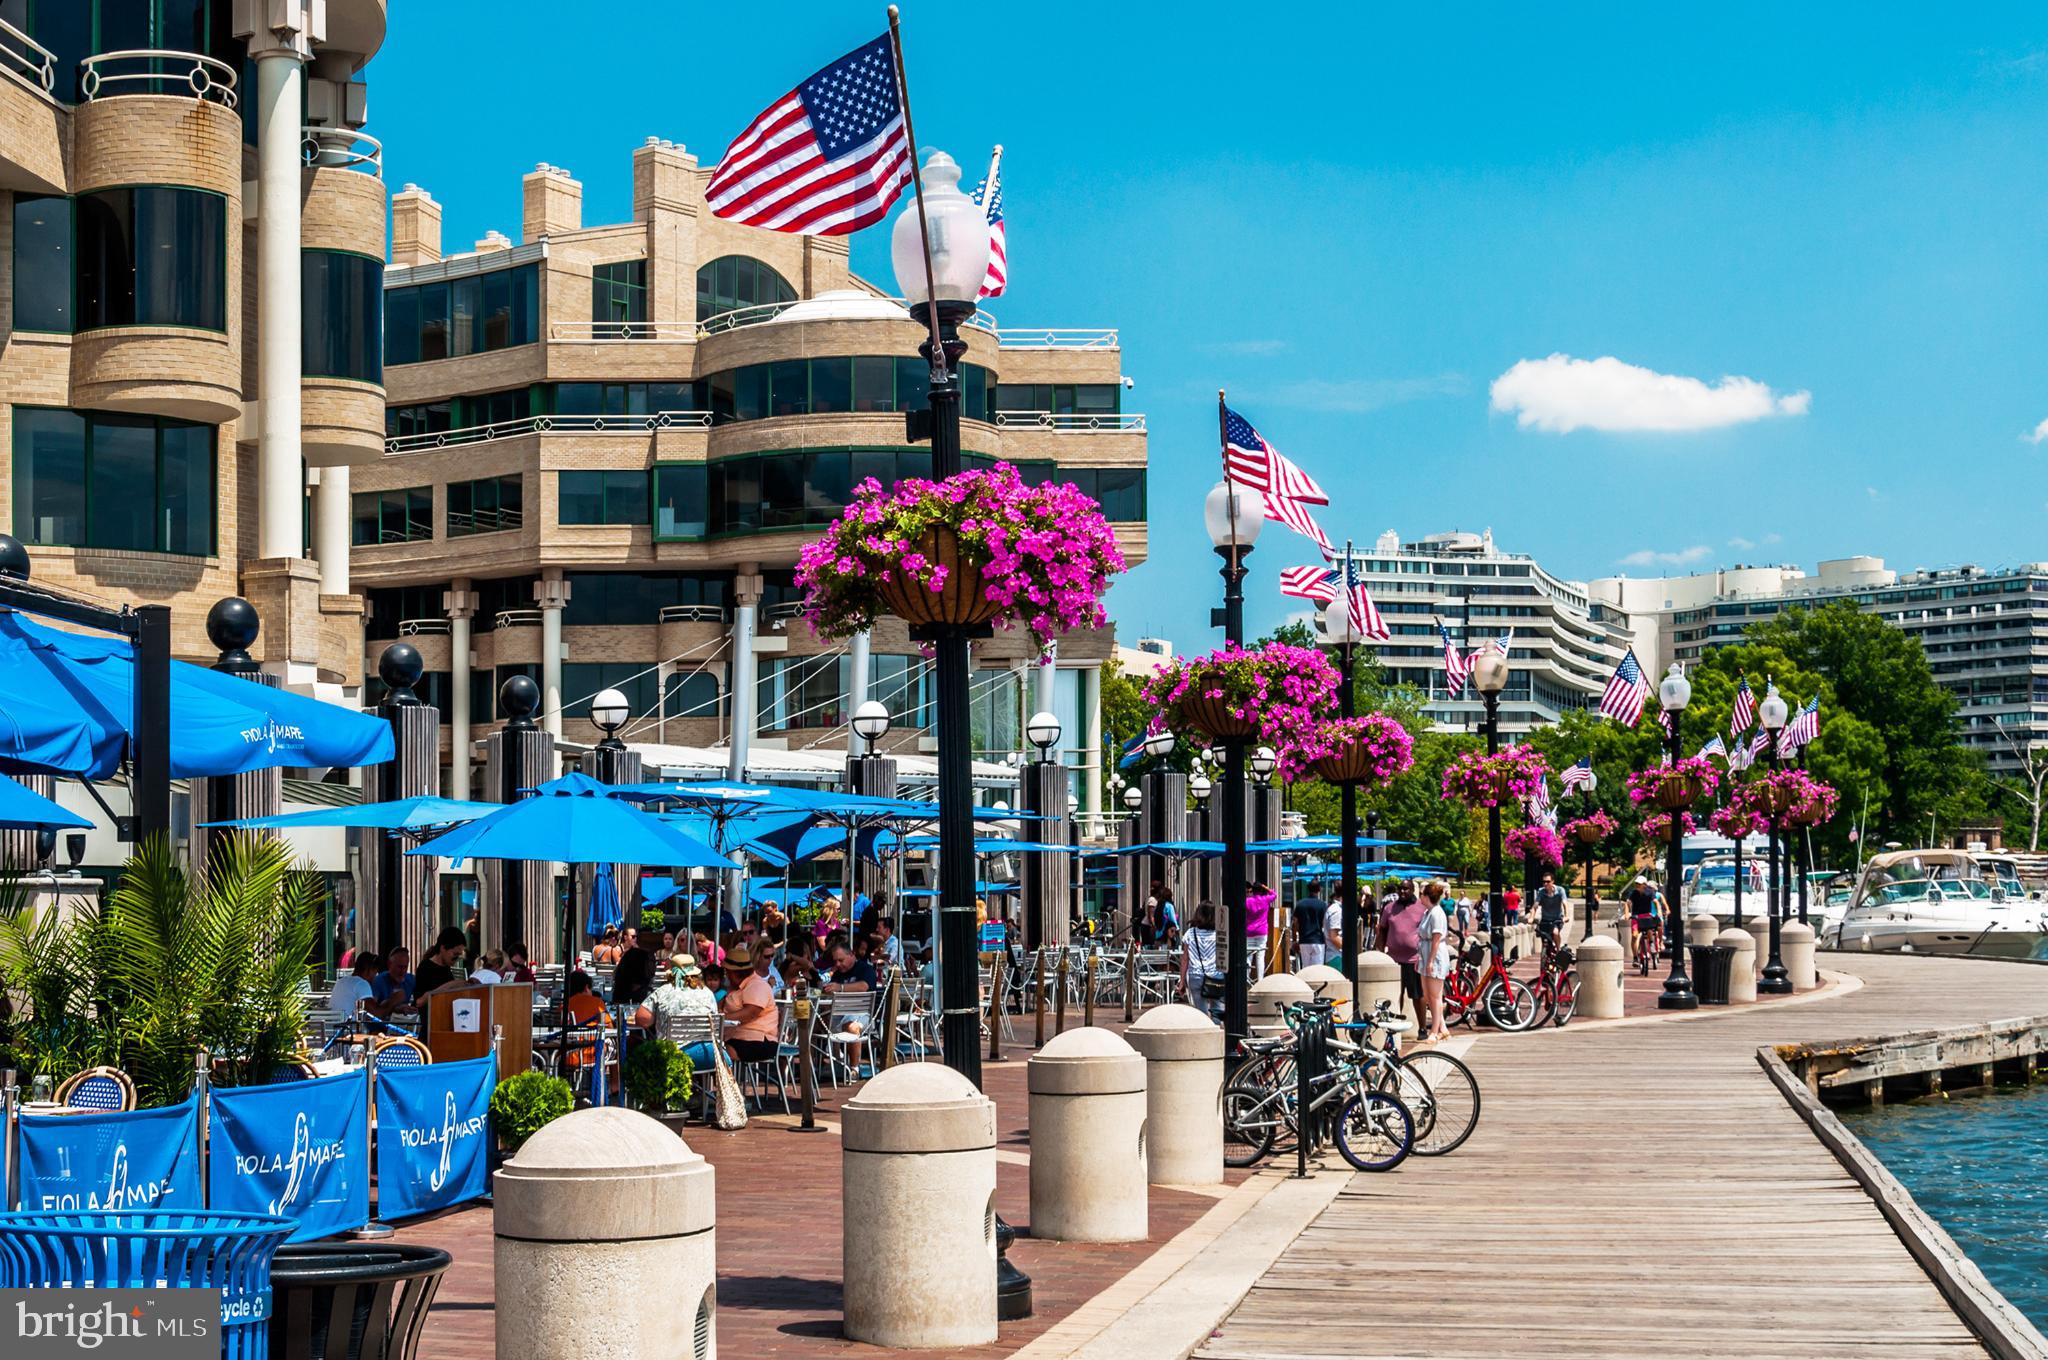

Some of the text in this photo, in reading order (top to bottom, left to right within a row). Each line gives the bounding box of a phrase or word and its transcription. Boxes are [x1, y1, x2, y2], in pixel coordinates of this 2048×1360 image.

[240, 725, 304, 743] FIOLA MARE
[401, 1127, 437, 1147] FIOLA
[127, 1179, 174, 1207] MAE
[221, 1298, 250, 1322] ycle
